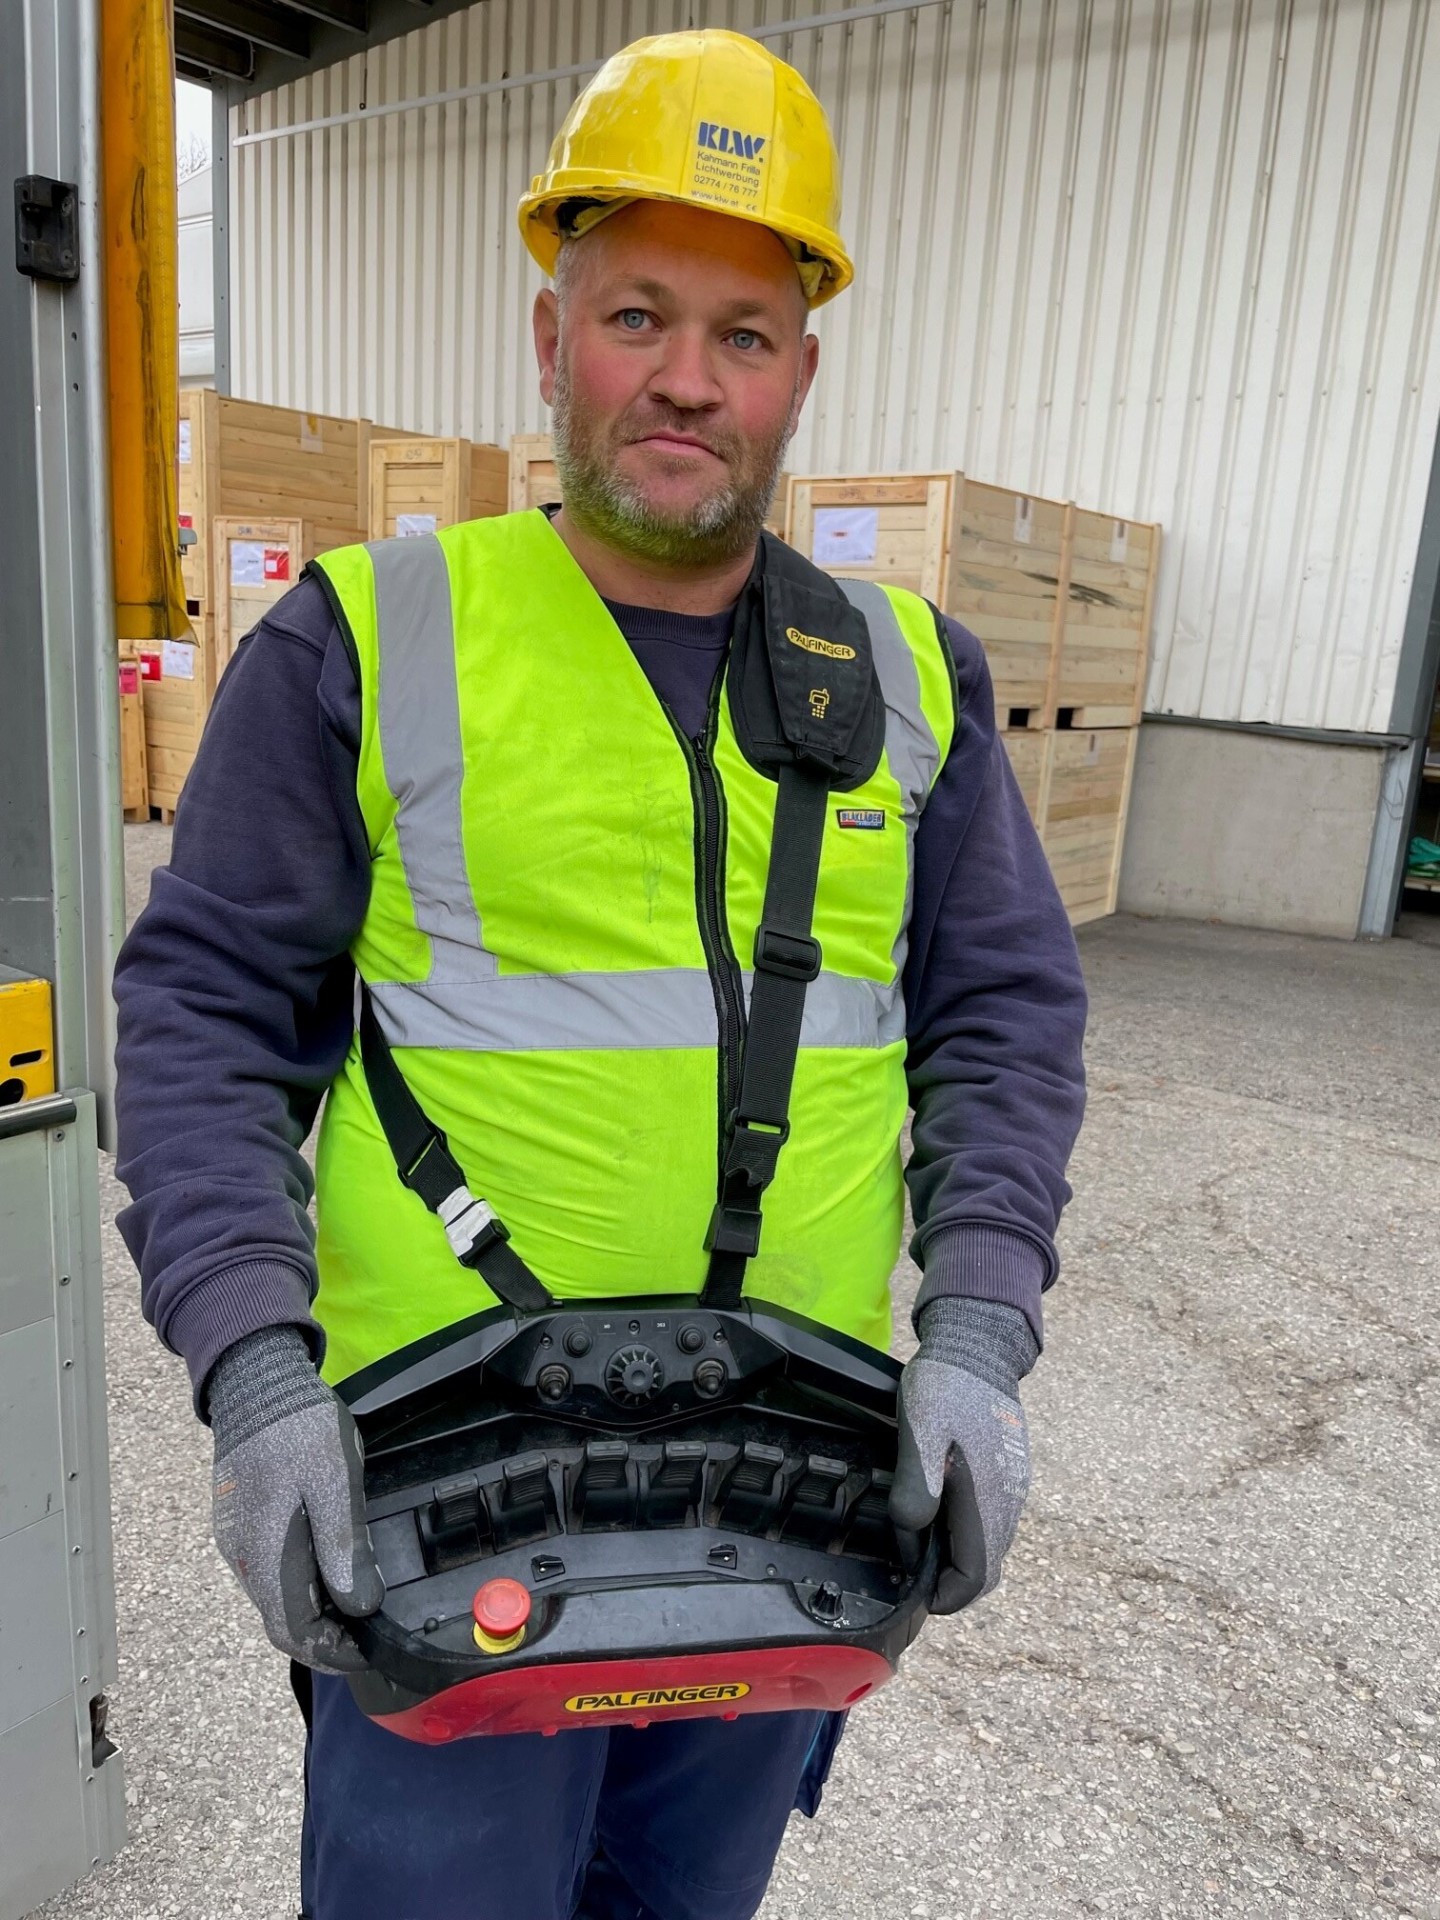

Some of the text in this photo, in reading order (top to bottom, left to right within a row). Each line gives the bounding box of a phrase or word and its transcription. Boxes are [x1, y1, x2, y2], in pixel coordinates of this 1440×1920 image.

[697, 151, 739, 170] Kahmann
[694, 174, 721, 189] 02774
[729, 183, 740, 194] 76
[742, 187, 758, 198] 777
[696, 161, 759, 187] Lichtwerbung
[790, 630, 851, 657] PALFINGER
[576, 1685, 740, 1710] PALFINGER
